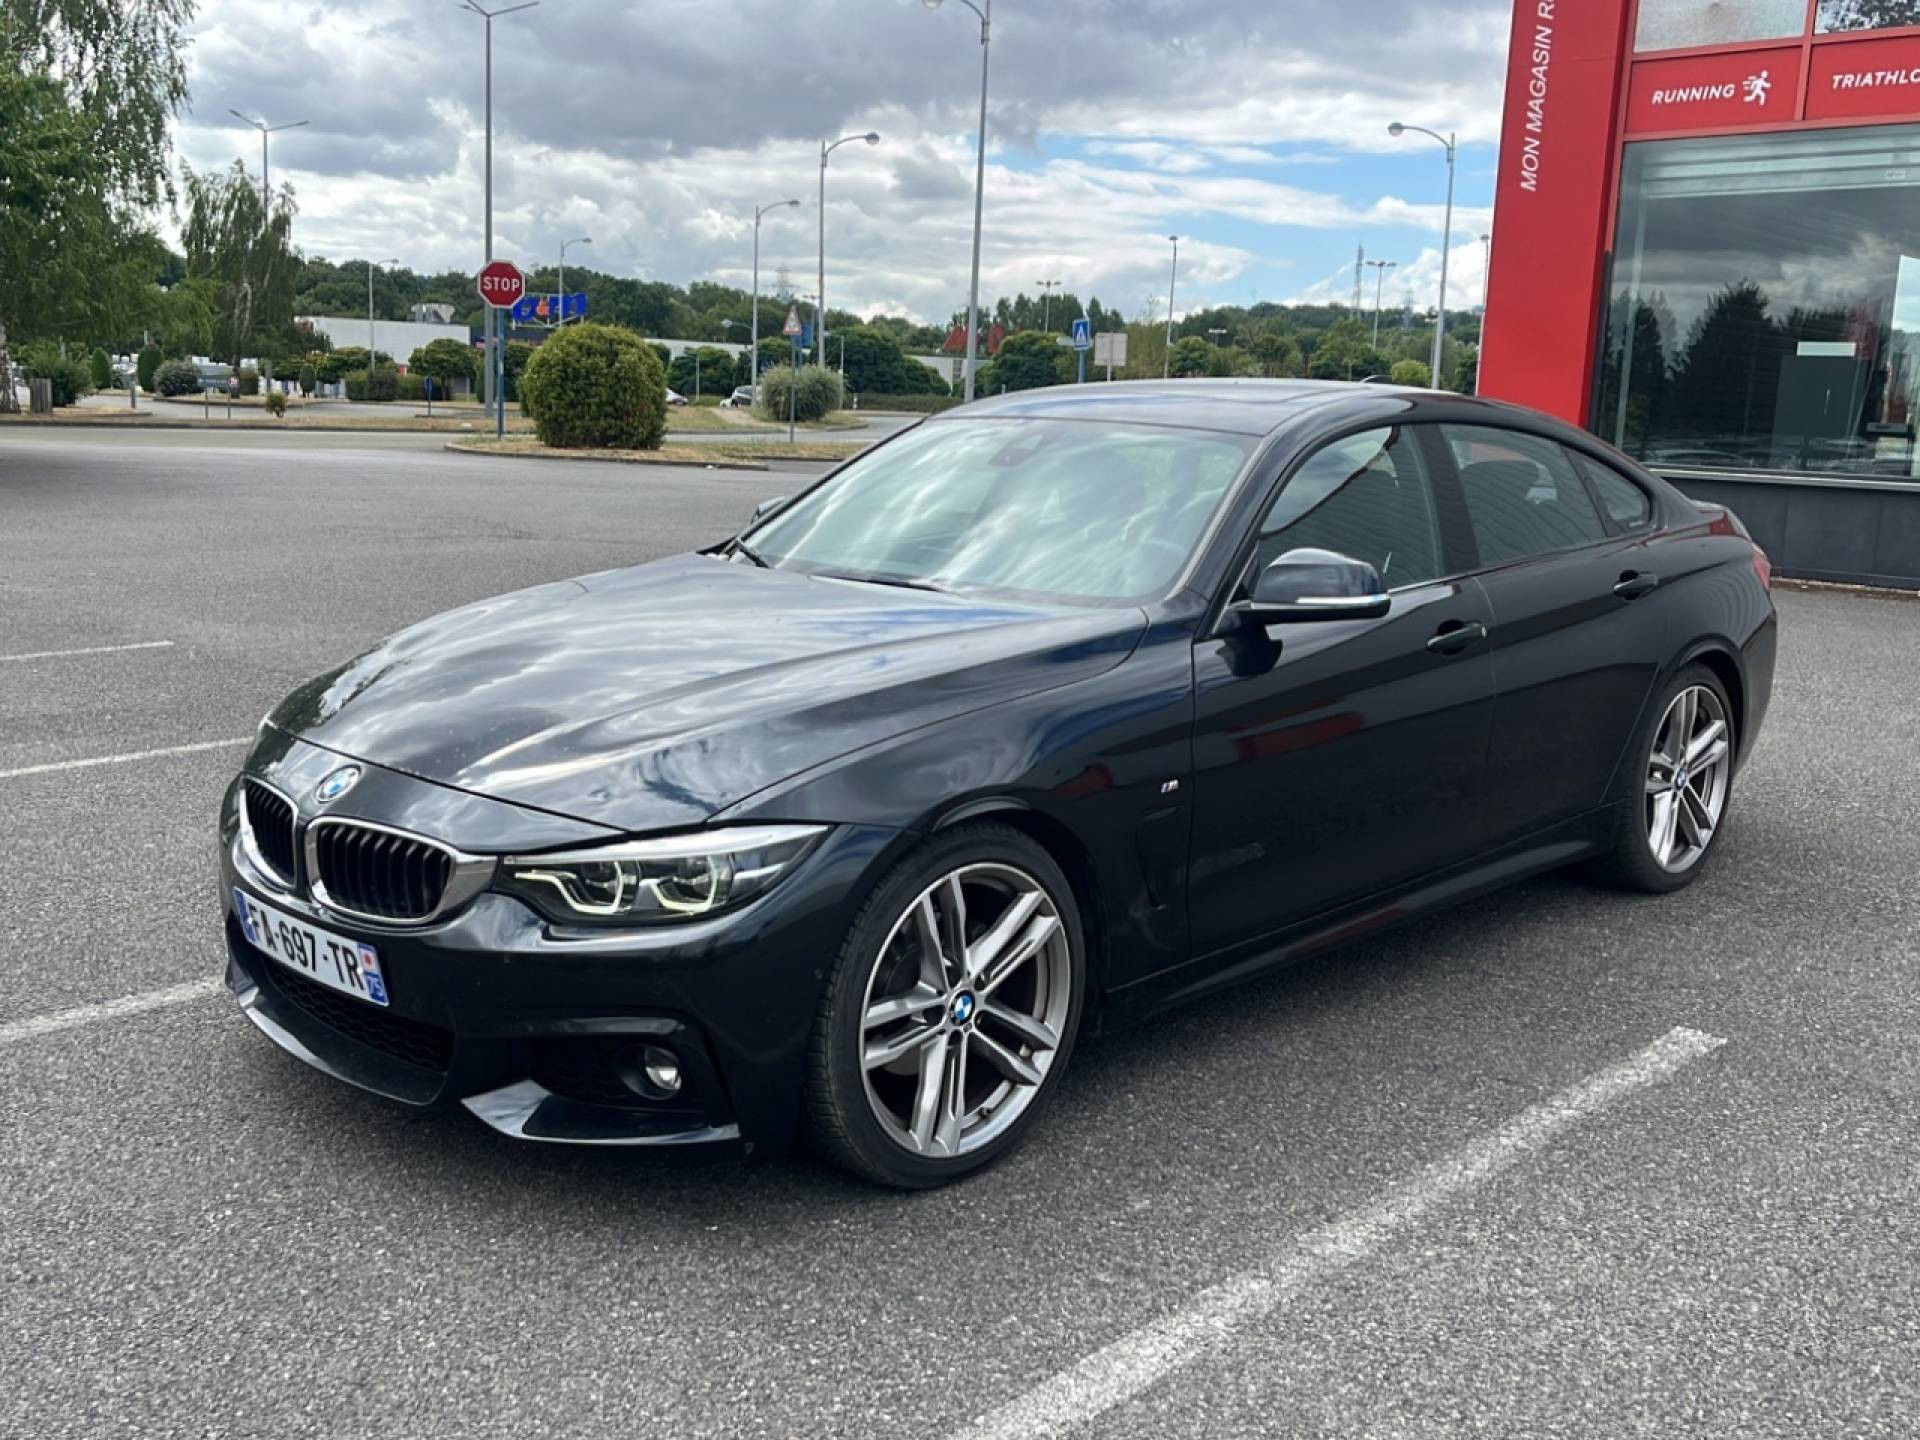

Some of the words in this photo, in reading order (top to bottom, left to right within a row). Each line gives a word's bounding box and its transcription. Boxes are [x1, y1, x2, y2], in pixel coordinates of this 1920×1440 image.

[1537, 0, 1555, 20] R
[1526, 25, 1553, 133] MAGASIN
[1652, 83, 1736, 105] RUNNING
[1520, 137, 1541, 192] MON
[483, 277, 520, 292] STOP
